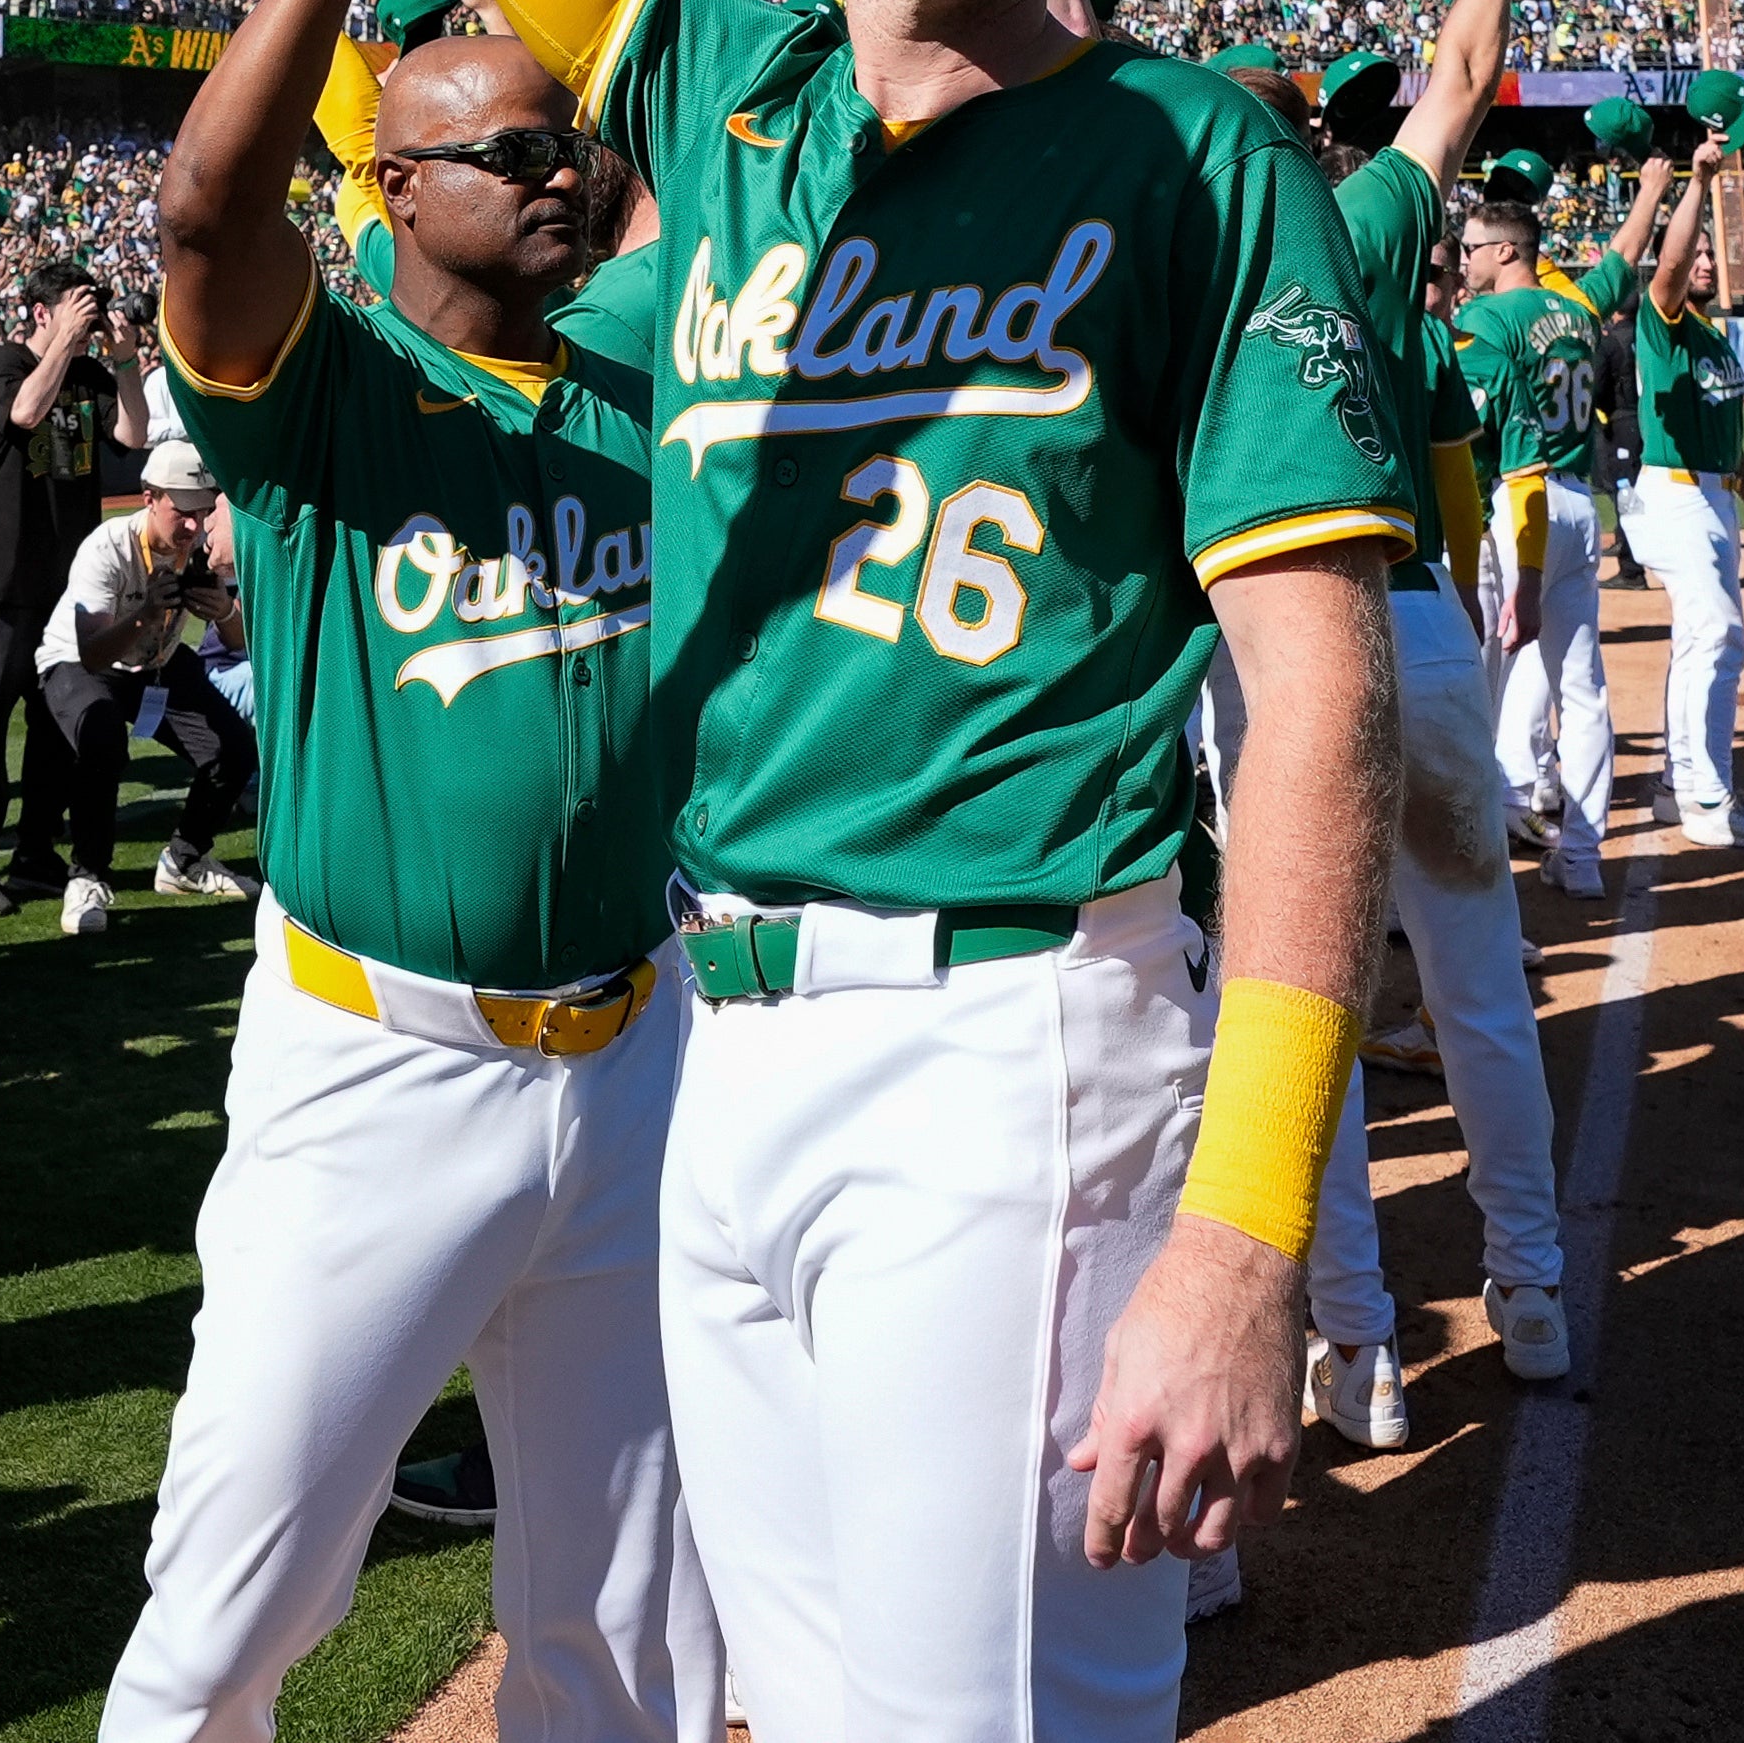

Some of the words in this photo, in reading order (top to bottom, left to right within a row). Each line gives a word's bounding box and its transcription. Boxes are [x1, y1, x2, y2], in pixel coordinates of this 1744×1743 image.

[121, 25, 165, 67] A's
[1540, 358, 1595, 434] 36
[812, 453, 1047, 668] 26
